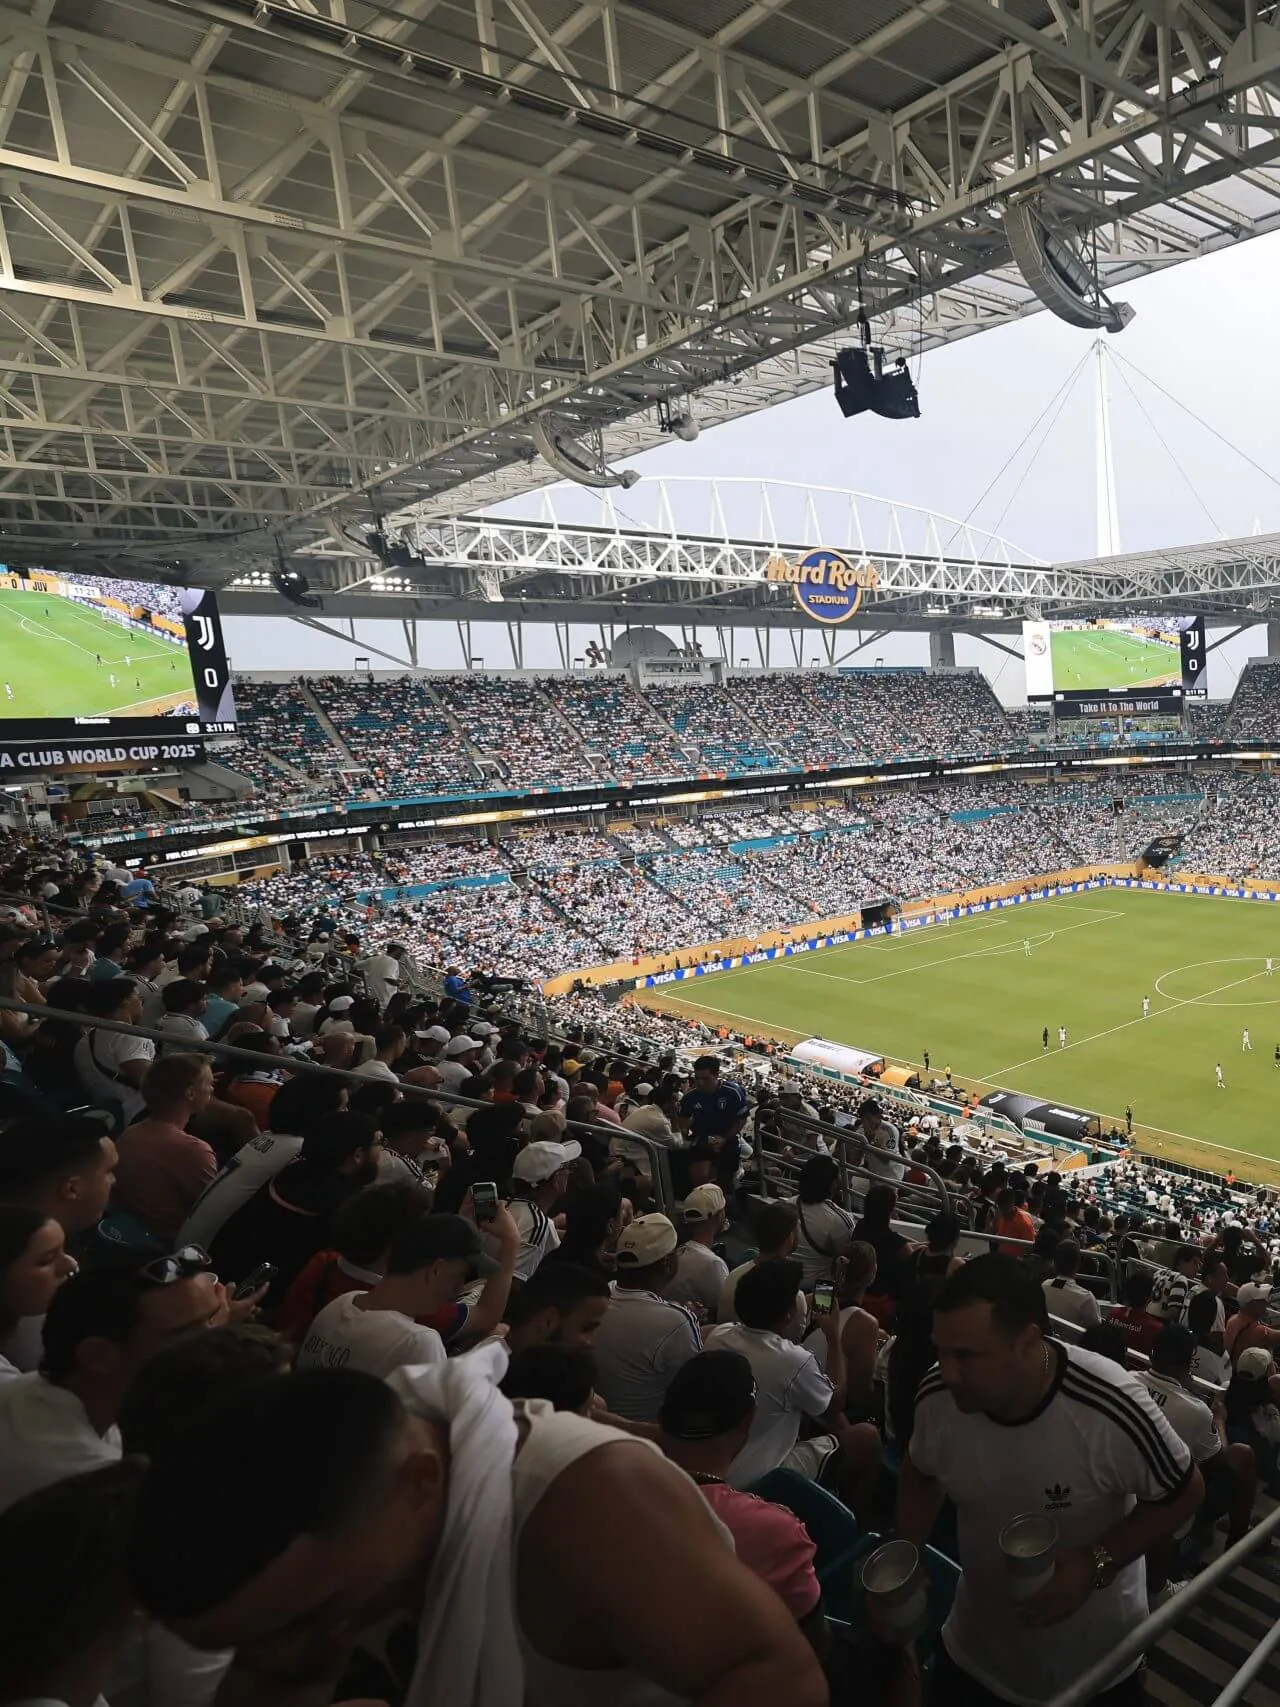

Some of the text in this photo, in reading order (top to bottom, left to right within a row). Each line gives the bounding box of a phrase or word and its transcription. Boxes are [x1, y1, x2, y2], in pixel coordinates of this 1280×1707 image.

[767, 556, 880, 592] Hard Rock
[33, 581, 48, 592] JUV
[808, 594, 849, 605] STADIUM
[1188, 658, 1198, 671] 0
[204, 668, 218, 688] 0
[1079, 703, 1098, 712] Take
[1120, 702, 1134, 711] The
[1135, 700, 1159, 711] World
[223, 723, 235, 732] PM
[17, 750, 65, 767] CLUB
[67, 746, 126, 764] WORLD
[129, 745, 158, 761] CUP
[171, 827, 189, 835] 1972
[904, 918, 920, 927] VISA
[870, 927, 886, 936] VISA
[830, 934, 849, 944] VISA
[791, 943, 810, 953] VISA
[748, 952, 768, 963] VISA
[701, 962, 723, 973] VISA
[653, 972, 676, 984] VISA
